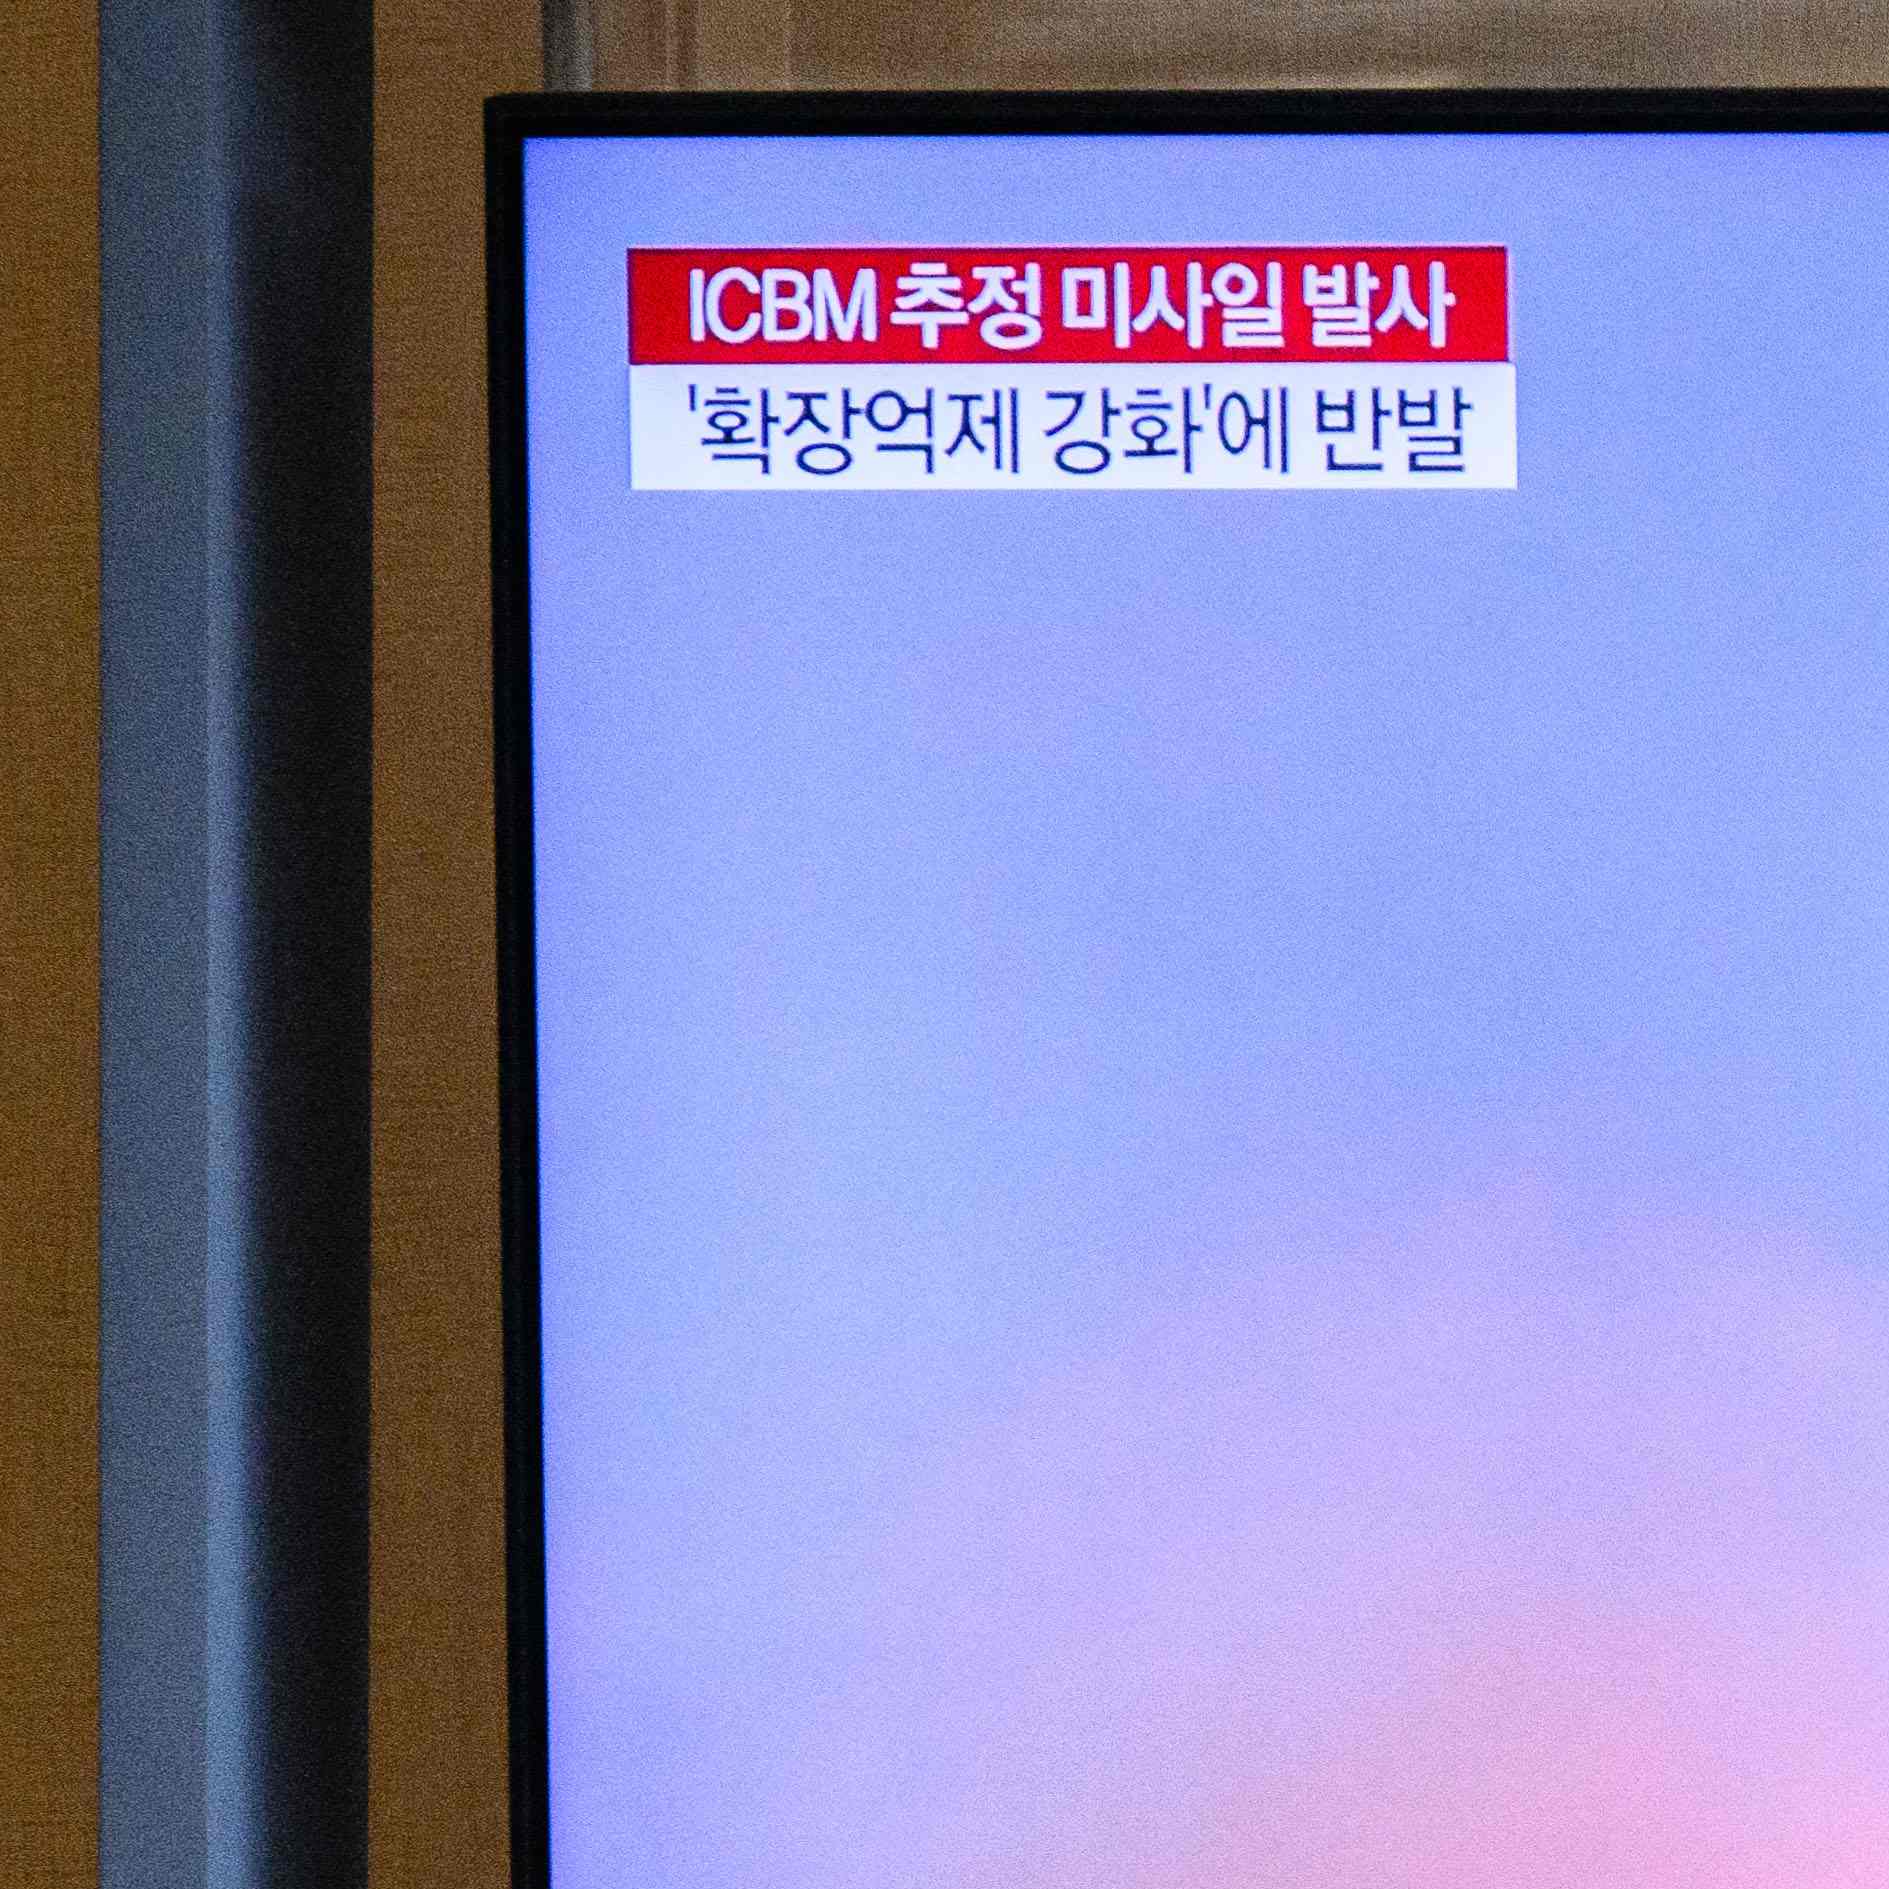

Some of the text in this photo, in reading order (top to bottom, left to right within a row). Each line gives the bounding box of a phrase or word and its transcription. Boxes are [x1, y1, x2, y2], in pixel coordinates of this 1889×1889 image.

[688, 261, 1458, 352] ICBM 추정 미사일 발사
[687, 383, 1475, 478] '확장억제 강화'에 반발
